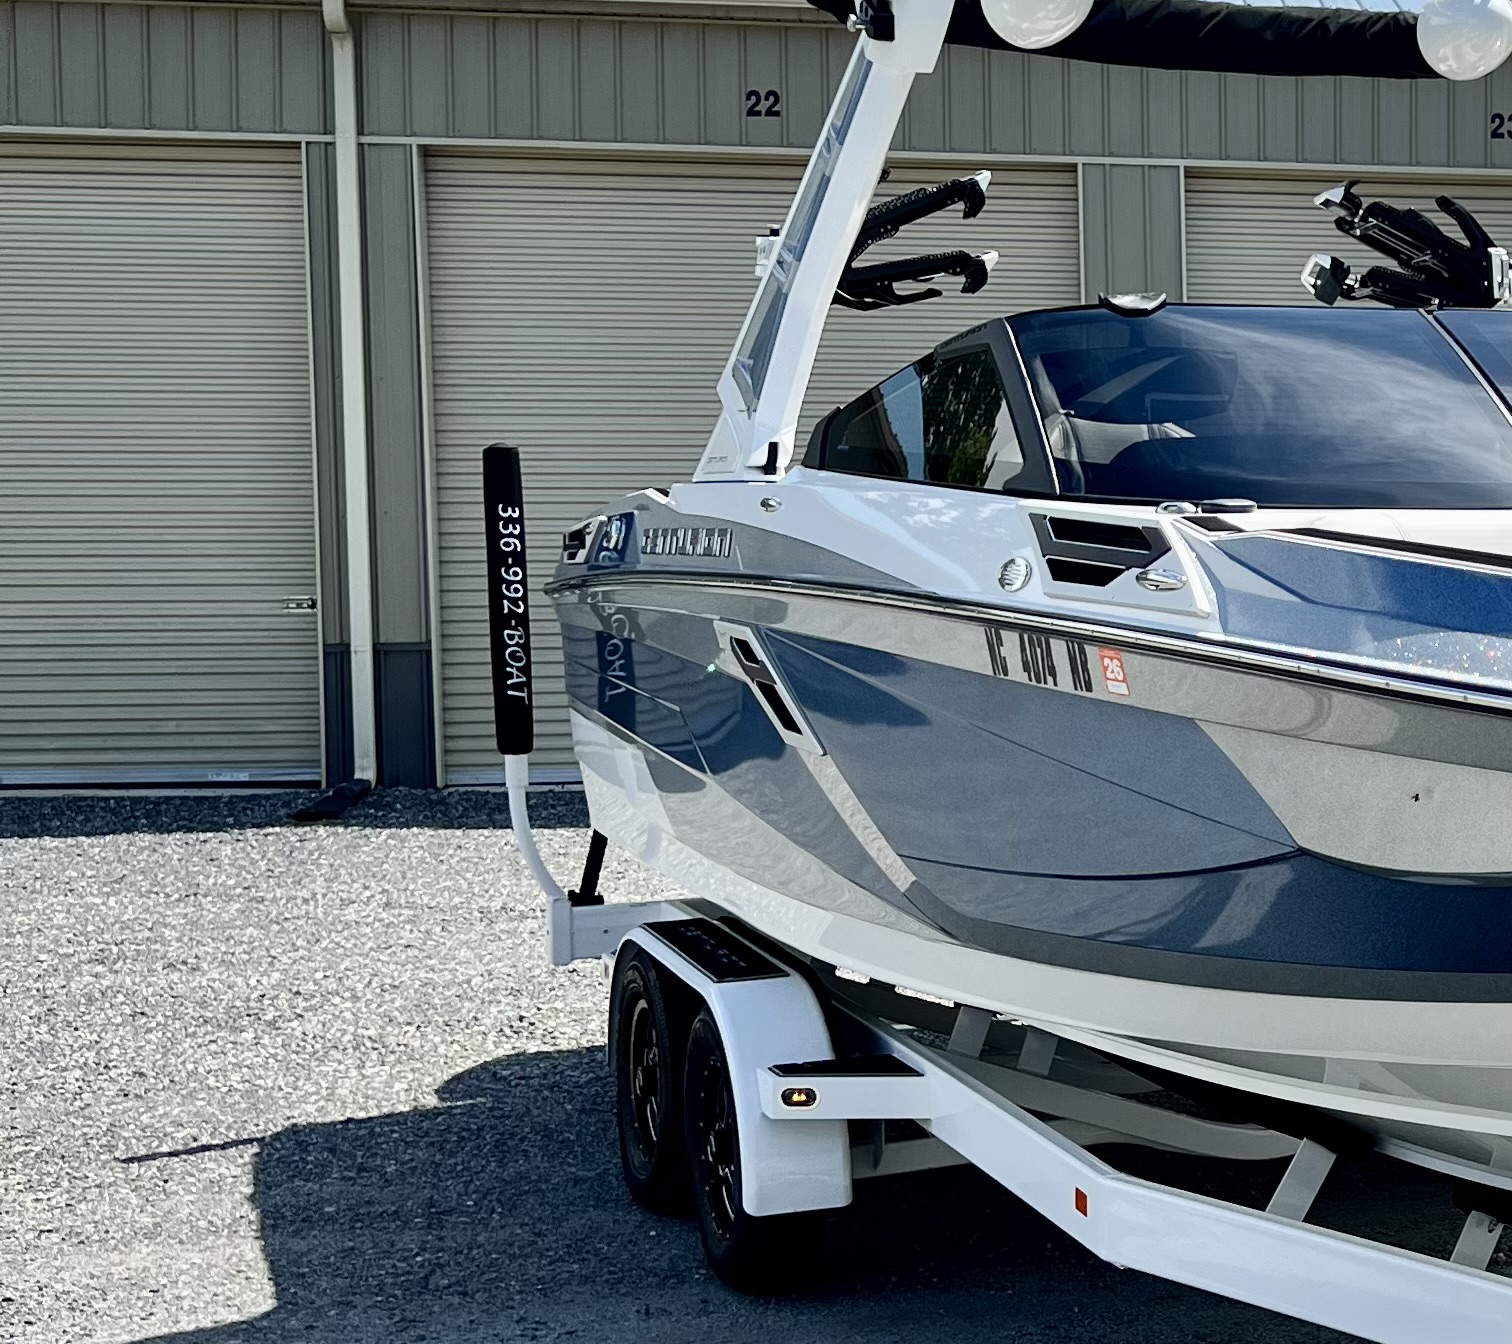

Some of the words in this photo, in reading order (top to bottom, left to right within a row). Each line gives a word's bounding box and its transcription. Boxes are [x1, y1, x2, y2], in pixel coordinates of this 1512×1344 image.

[745, 89, 781, 118] 22
[497, 503, 529, 705] 336-992-BOAT
[984, 627, 1009, 677] NC
[1018, 632, 1059, 688] 4074
[1065, 639, 1094, 693] NB
[1103, 657, 1124, 681] 26
